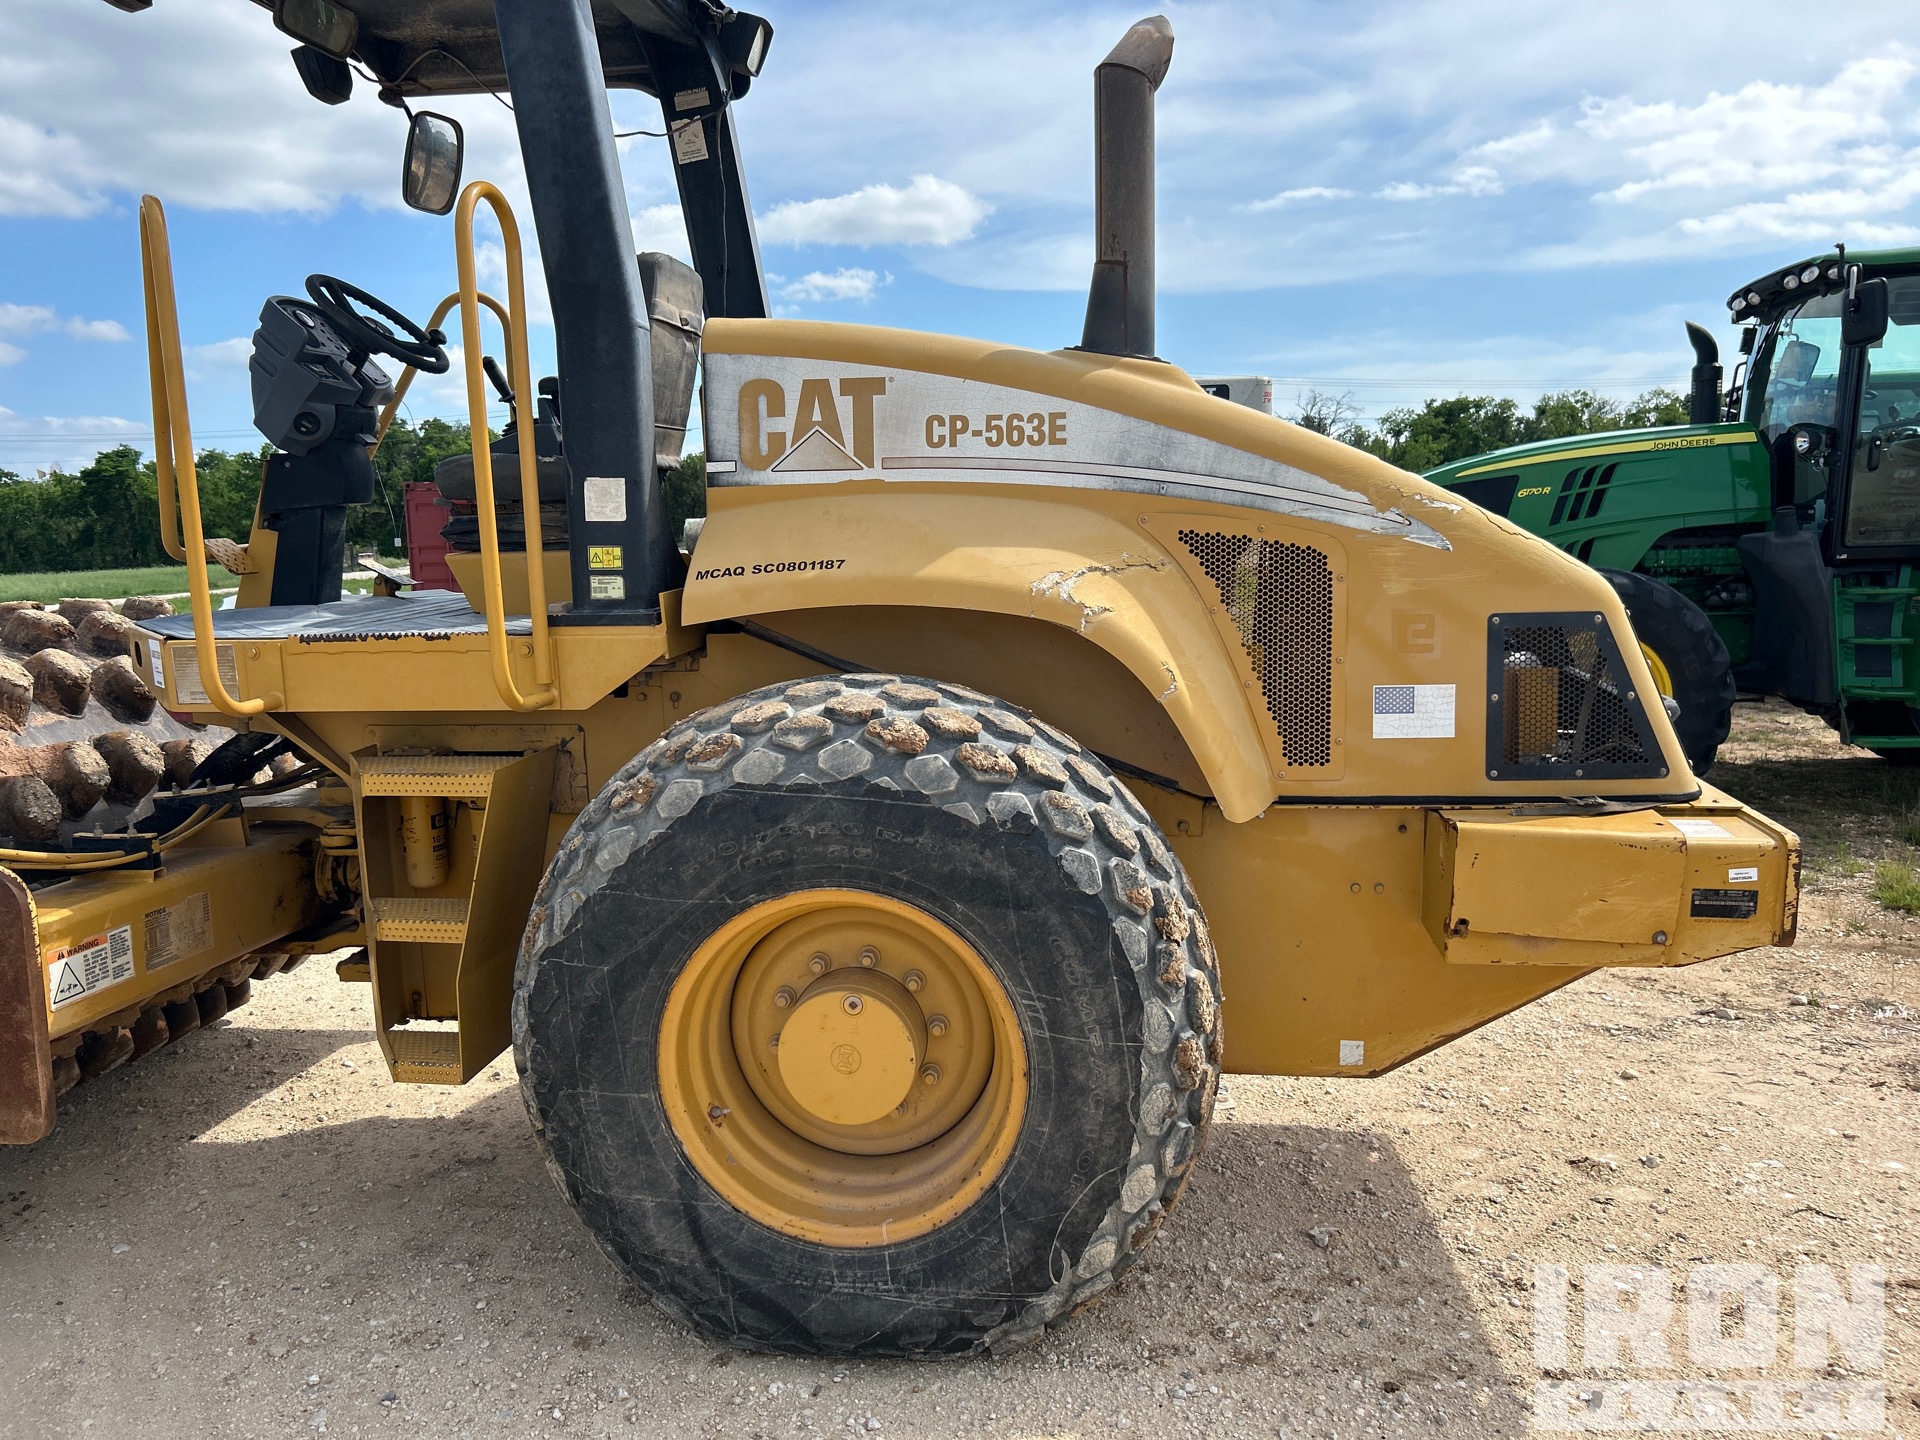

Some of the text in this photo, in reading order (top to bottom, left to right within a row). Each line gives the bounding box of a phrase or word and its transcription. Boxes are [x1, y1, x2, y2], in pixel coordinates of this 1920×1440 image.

[738, 376, 886, 472] CAT
[925, 411, 1067, 449] CP-563E
[1650, 437, 1716, 451] JOHN DEERE
[695, 559, 846, 580] MCAQ SC0801187
[144, 906, 167, 919] NOTICE
[67, 939, 99, 957] WARNING
